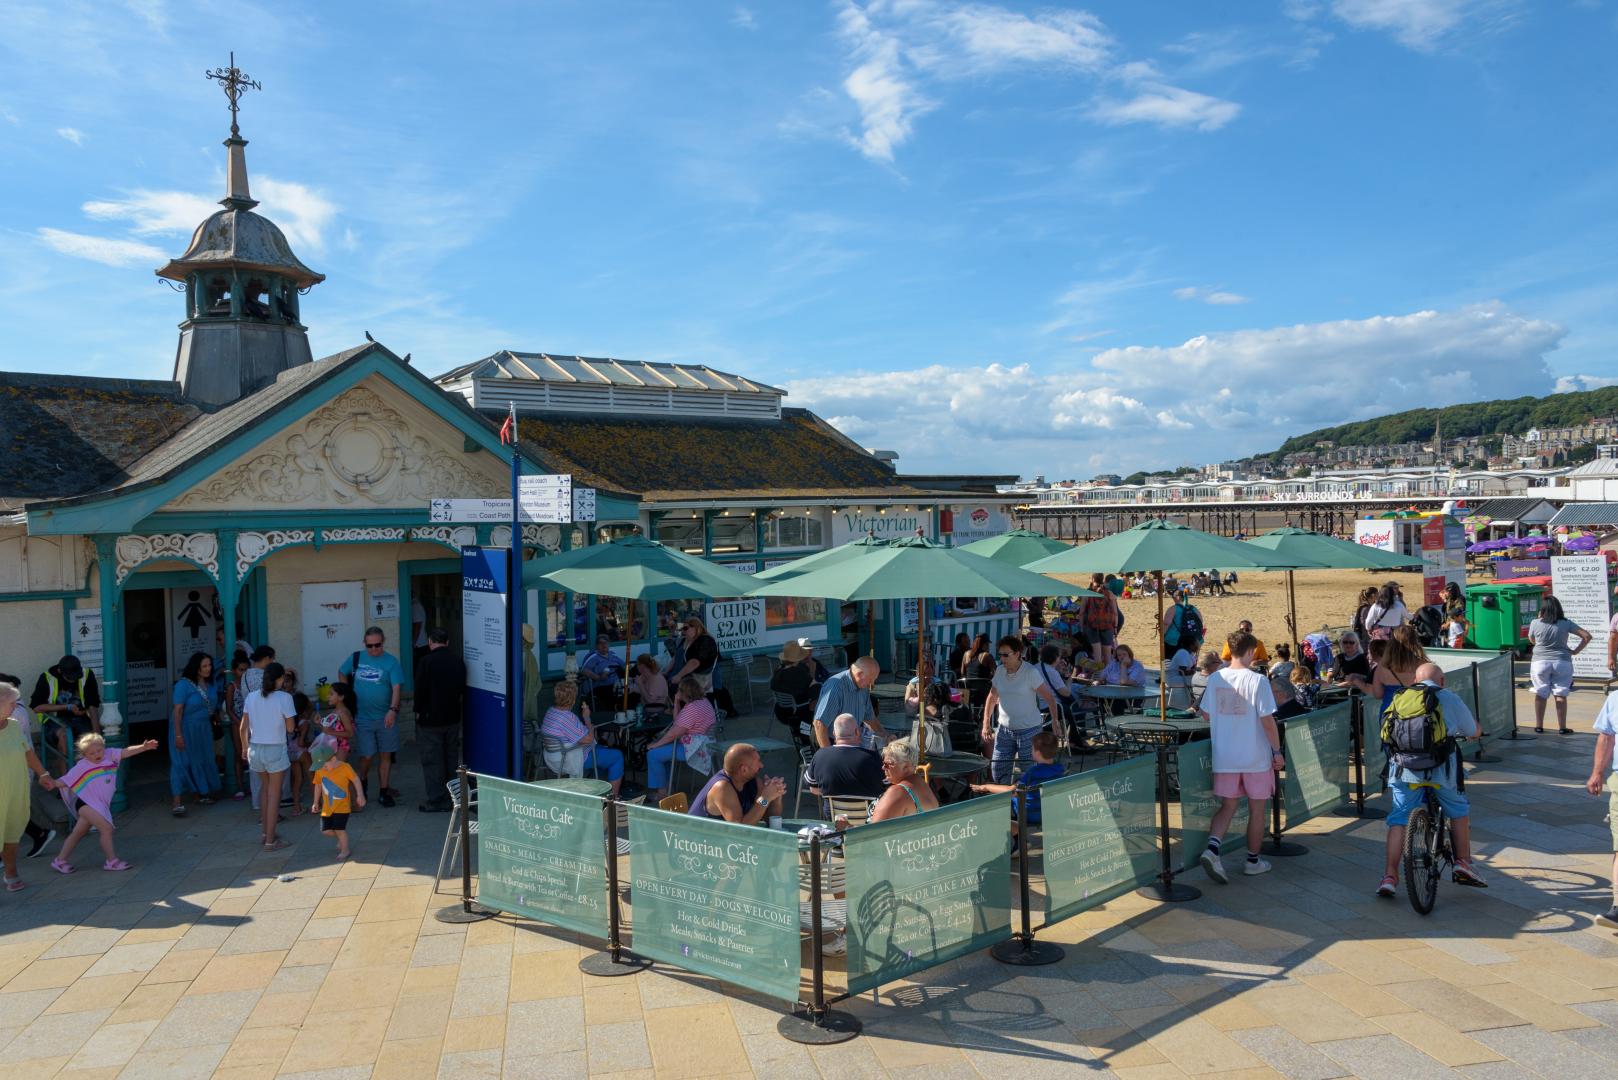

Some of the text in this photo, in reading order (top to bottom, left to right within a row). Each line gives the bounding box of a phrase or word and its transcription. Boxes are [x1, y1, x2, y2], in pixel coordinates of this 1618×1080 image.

[483, 500, 511, 508] Tropicana
[1273, 490, 1372, 501] SKY SURROUNDS US
[844, 513, 917, 533] Victorian
[1360, 530, 1391, 545] Seafood
[711, 602, 760, 619] CHIPS
[716, 619, 756, 639] £2.00
[718, 637, 757, 650] PORTION
[1068, 777, 1133, 809] Victorian Cafe
[503, 796, 574, 825] Victorian Cafe
[663, 830, 759, 866] Victorian Cafe
[884, 819, 978, 858] Victorian Cafe
[1048, 848, 1066, 862] OPEN
[1067, 841, 1086, 855] EVERY
[1087, 837, 1100, 847] DAY
[484, 841, 511, 854] SNACKS
[518, 849, 541, 862] MEALS
[549, 856, 576, 870] CREAM
[577, 862, 598, 875] TEAS
[511, 865, 523, 876] Cod
[529, 870, 547, 882] Chips
[524, 881, 537, 892] with
[537, 884, 547, 894] Tea
[547, 888, 555, 896] or
[554, 889, 574, 902] Coffee
[901, 894, 912, 905] IN
[914, 888, 929, 900] OR
[931, 879, 957, 896] TAKE
[960, 872, 985, 888] AWAY
[636, 879, 658, 892] OPEN
[660, 882, 687, 899] EVERY
[689, 890, 707, 904] DAY
[714, 898, 741, 912] DOGS
[742, 904, 792, 926] WELCOME
[939, 904, 953, 916] Egg
[677, 910, 747, 936] Hot & Cold Drinks
[896, 933, 908, 944] Tea
[909, 932, 917, 940] or
[947, 914, 971, 928] £4.25
[694, 929, 717, 945] Snacks
[718, 935, 726, 946] &
[727, 938, 754, 955] Pastries
